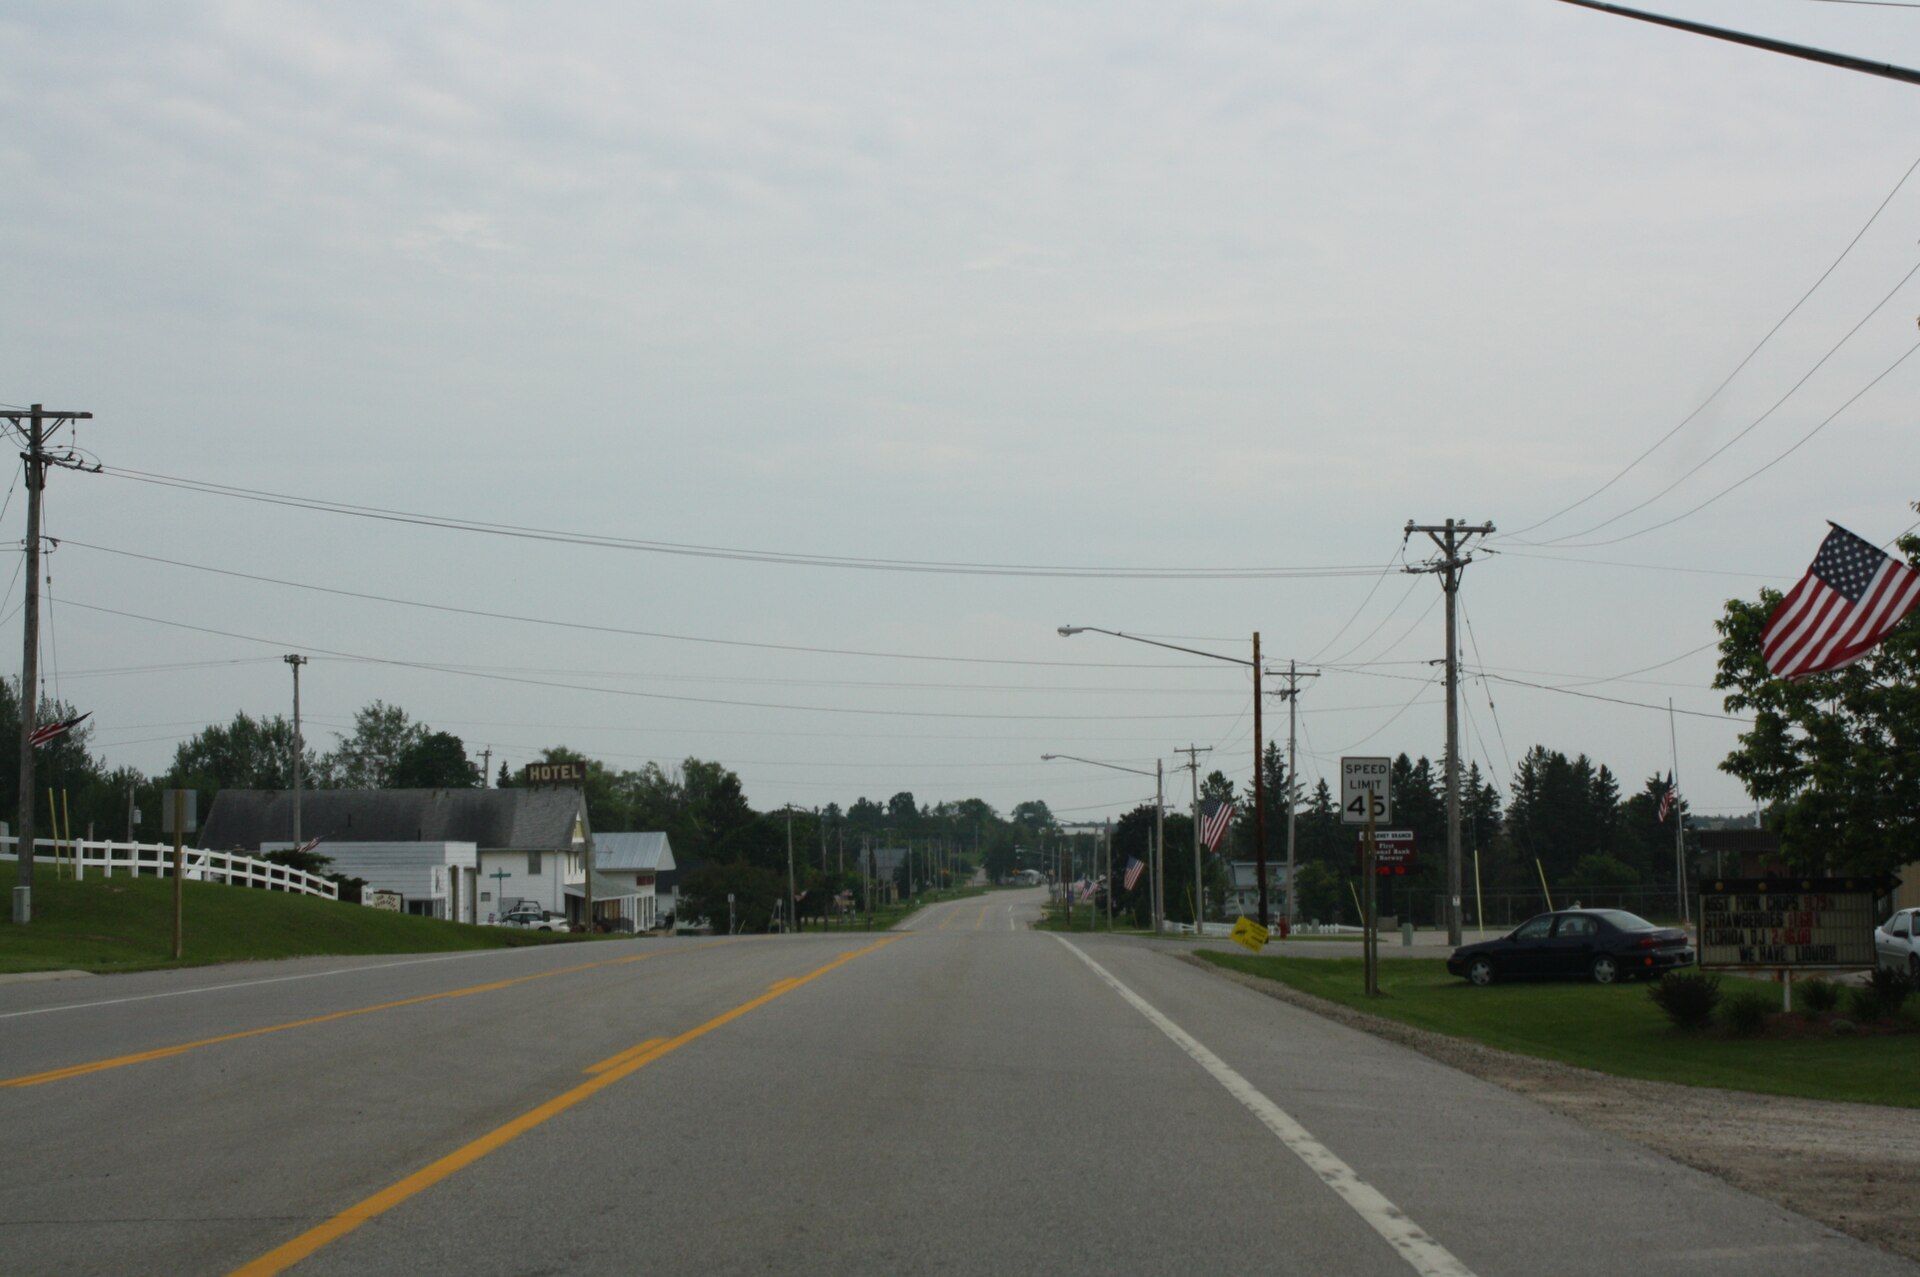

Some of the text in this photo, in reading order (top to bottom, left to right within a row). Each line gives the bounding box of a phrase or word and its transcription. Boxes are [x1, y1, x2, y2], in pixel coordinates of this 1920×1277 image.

[529, 764, 581, 780] HOTEL
[1345, 764, 1387, 774] SPEED
[1350, 780, 1382, 789] LIMIT
[1346, 796, 1386, 816] 45
[1736, 895, 1760, 910] PORK
[1767, 895, 1799, 910] CHOPS
[1704, 912, 1783, 928] STRAWBERRIES
[1704, 928, 1745, 945] FLORIDA
[1739, 945, 1755, 962] WE
[1759, 945, 1786, 961] HAVE
